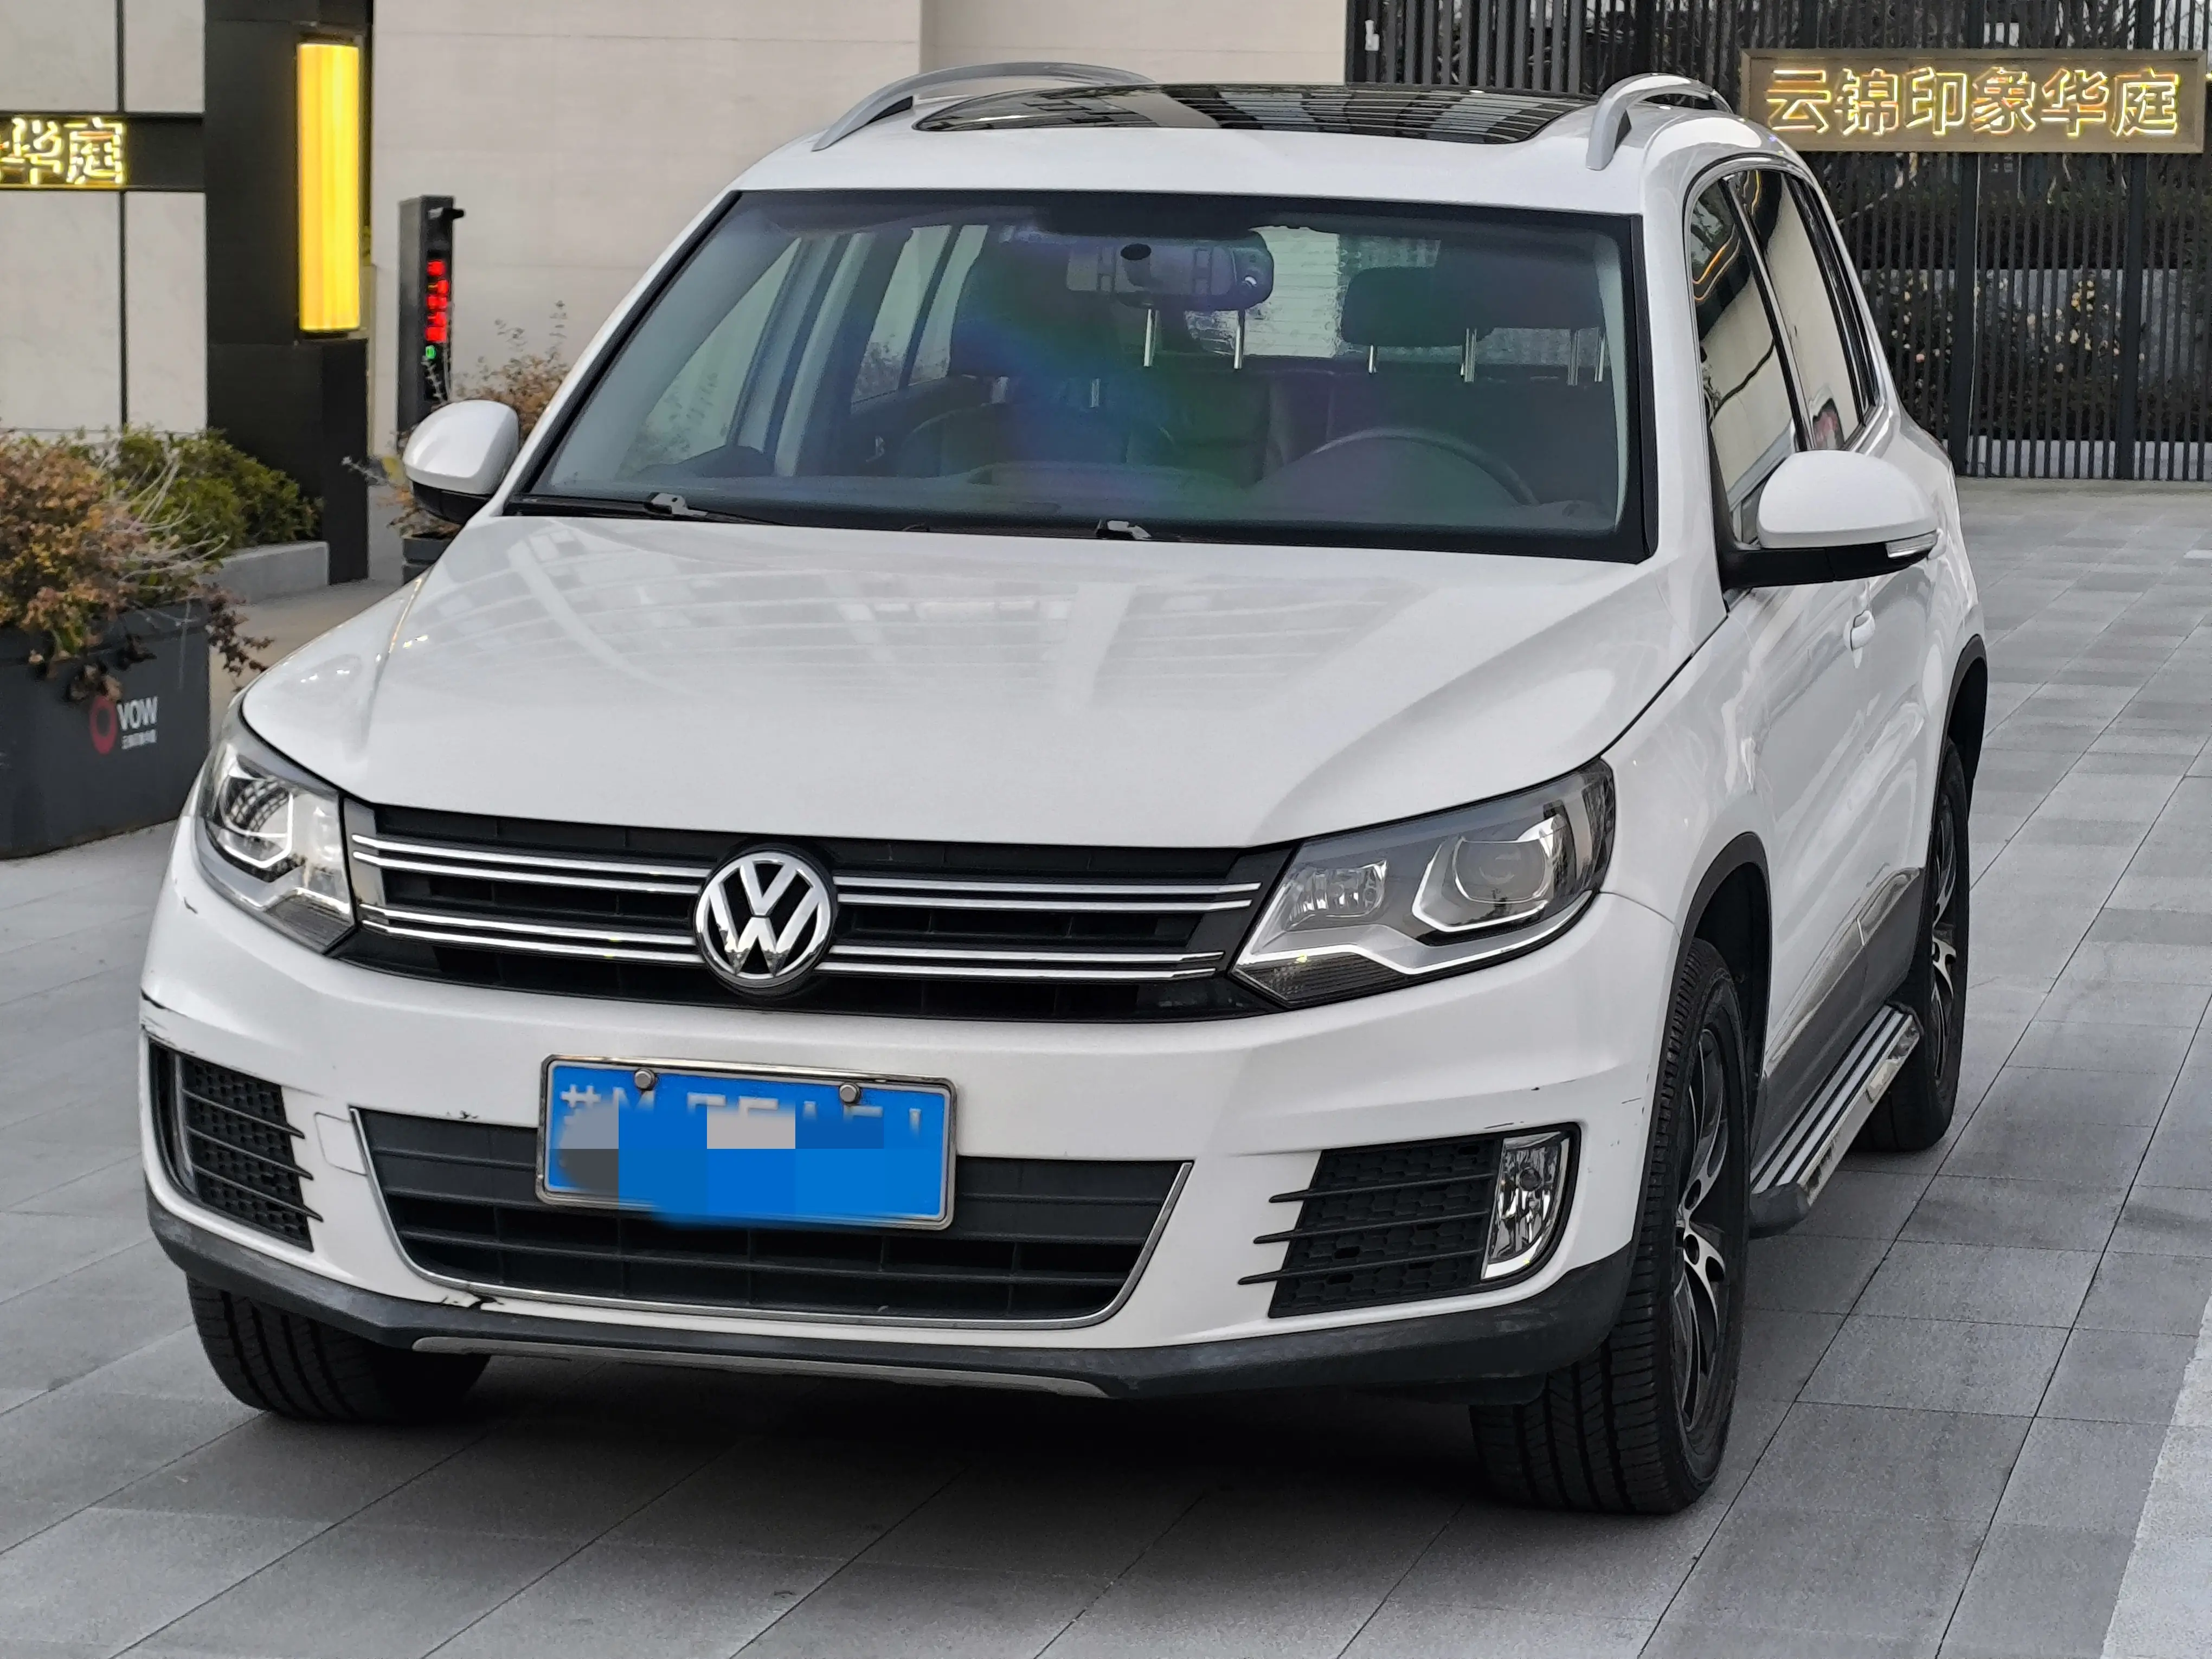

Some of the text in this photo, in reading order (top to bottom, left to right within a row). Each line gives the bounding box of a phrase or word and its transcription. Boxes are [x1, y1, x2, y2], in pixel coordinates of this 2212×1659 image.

[1765, 66, 2181, 137] 云锦印象华庭
[116, 695, 159, 731] VOW
